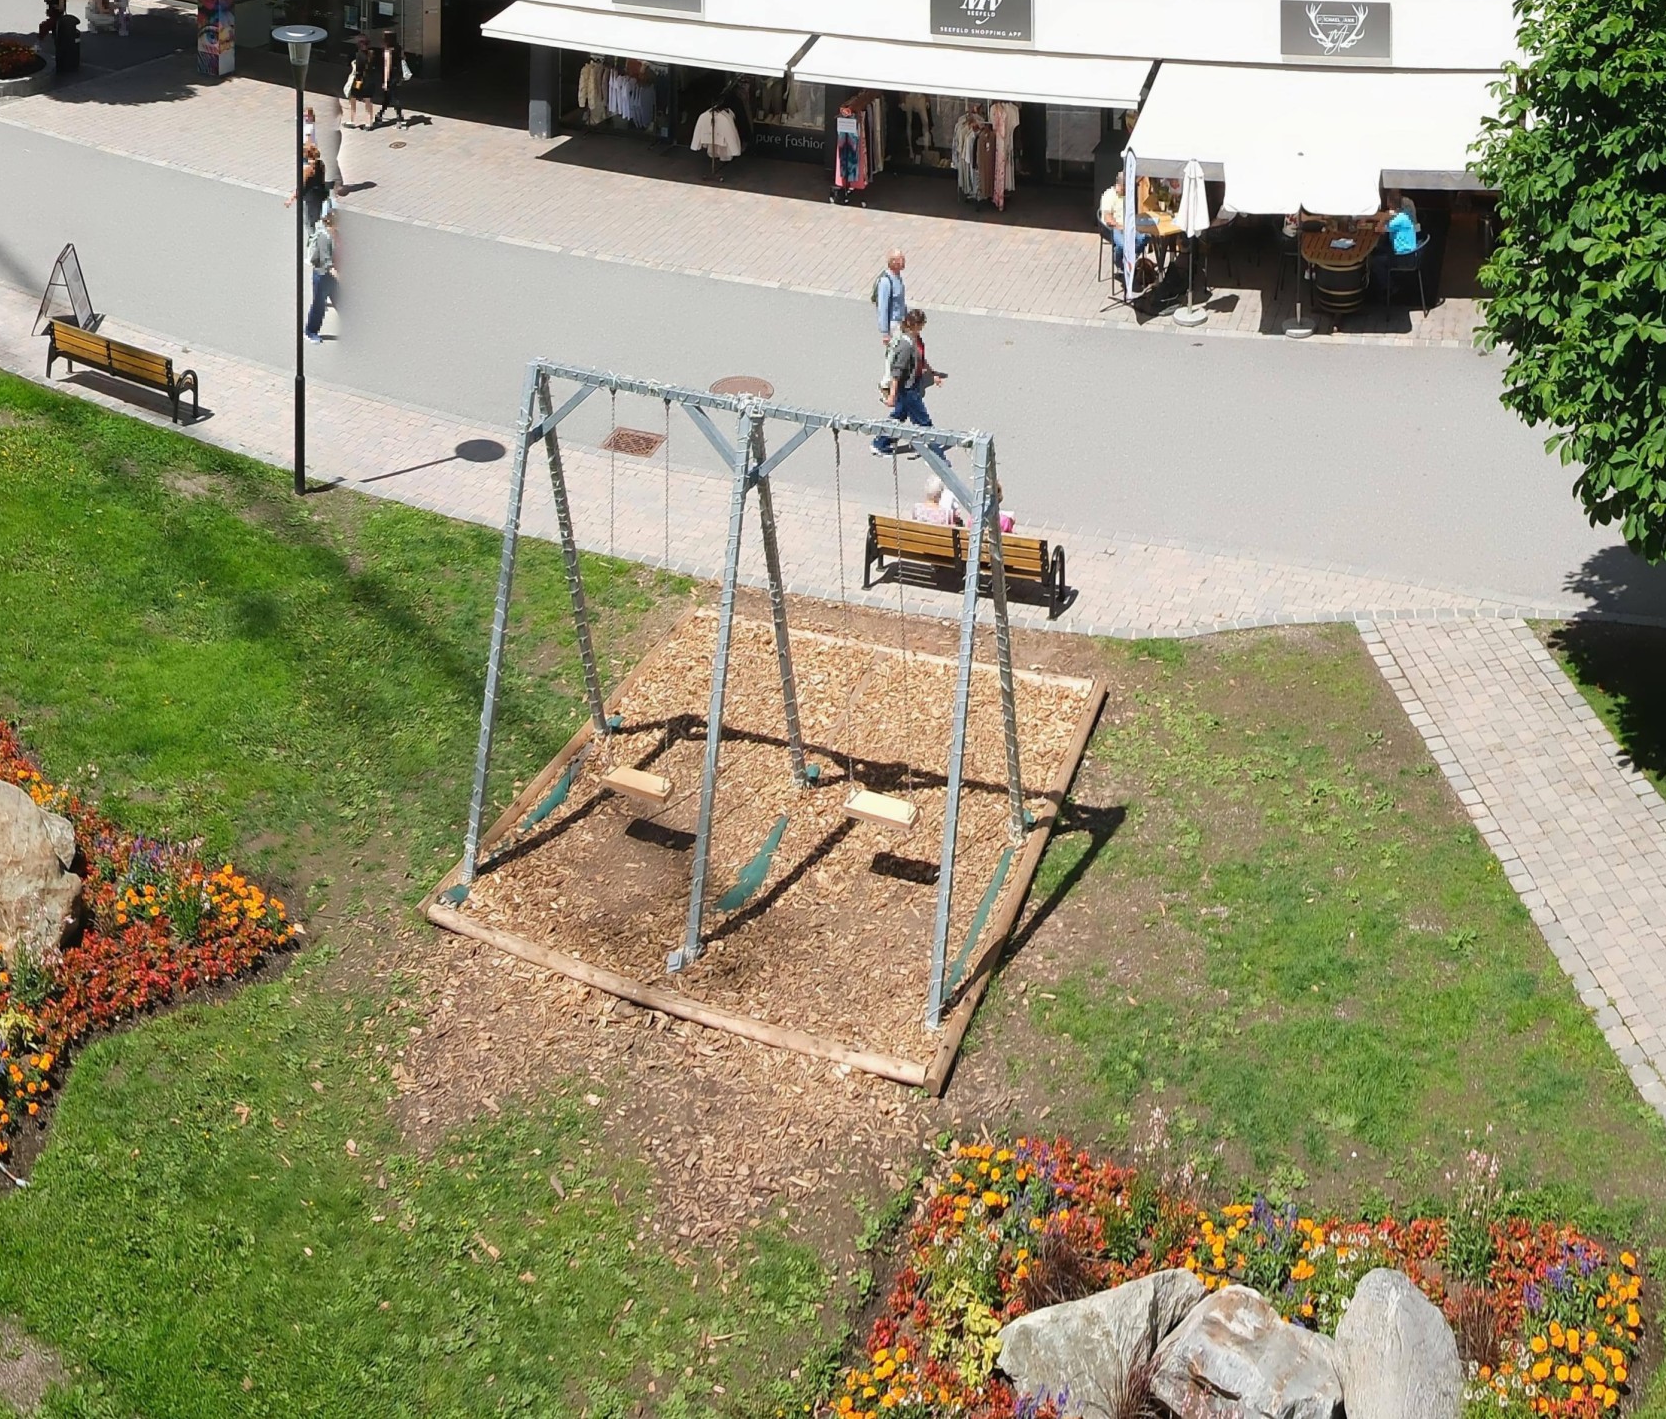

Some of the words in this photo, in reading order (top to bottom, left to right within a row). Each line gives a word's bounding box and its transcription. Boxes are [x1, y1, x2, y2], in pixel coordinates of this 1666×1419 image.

[967, 10, 996, 18] SEEFELD
[940, 26, 969, 34] SEEFELD
[971, 29, 1006, 37] SHOPPING
[755, 134, 781, 145] pure
